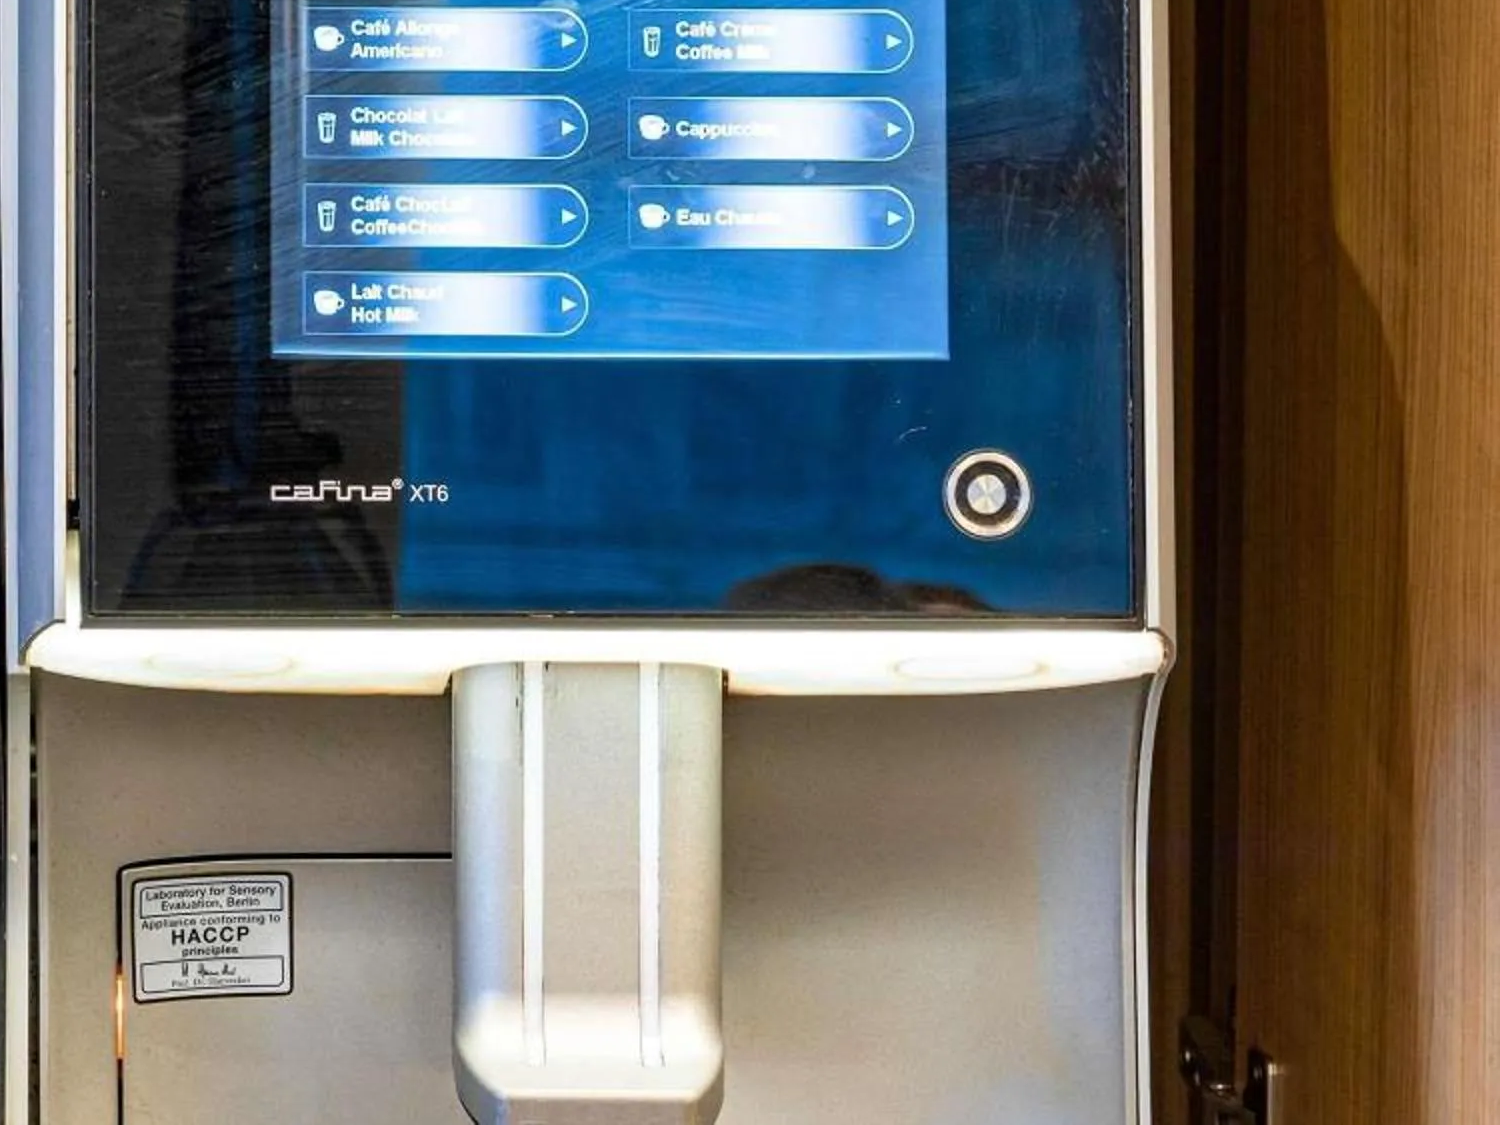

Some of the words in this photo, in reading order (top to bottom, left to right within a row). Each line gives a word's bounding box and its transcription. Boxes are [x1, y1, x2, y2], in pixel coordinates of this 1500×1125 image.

[351, 18, 391, 36] Café
[675, 20, 717, 38] Café
[675, 43, 734, 60] Coffee
[350, 106, 427, 125] Chocolat
[349, 129, 384, 147] Milk
[675, 120, 780, 140] Cappucc
[351, 194, 391, 213] Café
[675, 207, 712, 226] Eau
[351, 282, 383, 301] Lait
[351, 306, 382, 324] Hot
[409, 483, 450, 503] XT6
[145, 886, 207, 901] Laboratory
[209, 884, 226, 897] for
[229, 883, 278, 897] Sensory
[160, 896, 224, 912] Evaluation,
[226, 895, 261, 910] Berlin
[141, 916, 198, 931] Appliance
[199, 913, 266, 926] conforming
[269, 912, 282, 924] to
[171, 926, 250, 946] HACCP
[181, 945, 240, 958] principles
